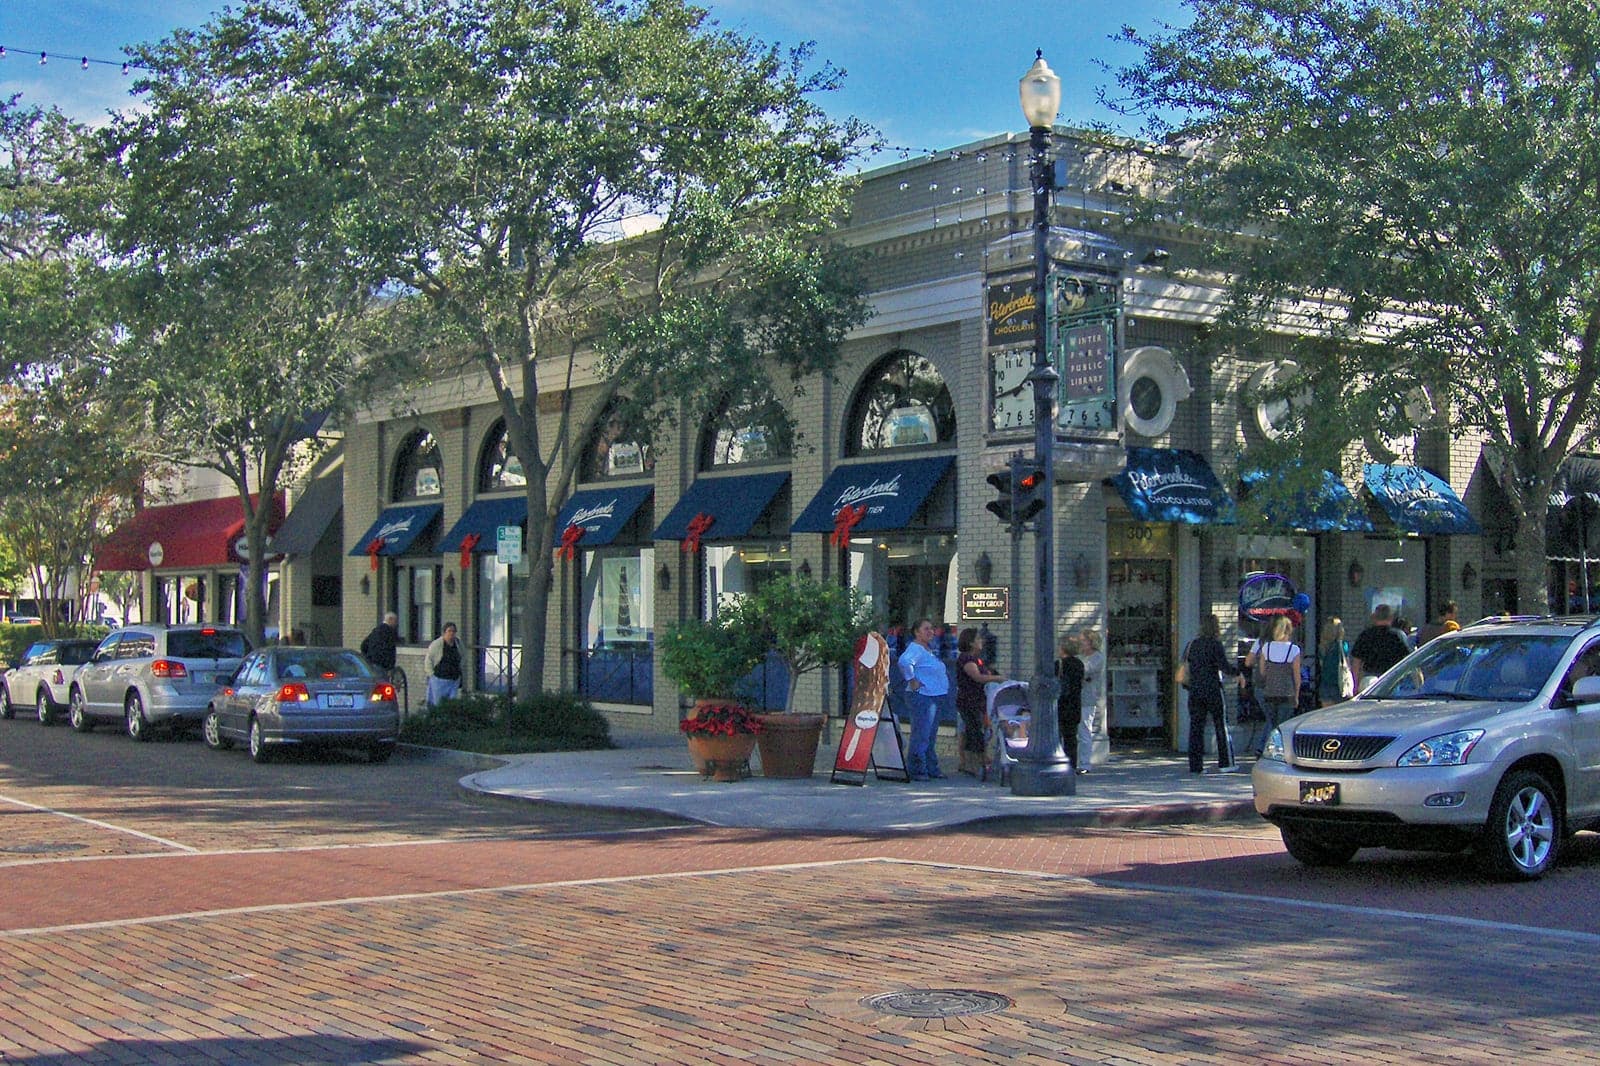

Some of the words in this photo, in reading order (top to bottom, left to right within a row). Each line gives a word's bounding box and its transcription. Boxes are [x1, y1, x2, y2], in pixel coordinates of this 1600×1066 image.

[1070, 335, 1102, 346] WINTER
[1070, 361, 1103, 373] PUBLIC
[998, 370, 1005, 381] 10
[1070, 375, 1103, 386] LIBRARY
[1006, 412, 1011, 423] 7
[1017, 410, 1023, 421] 6
[1029, 409, 1034, 420] 5
[1070, 409, 1075, 420] 7
[1081, 410, 1088, 421] 6
[1095, 411, 1100, 423] 5
[1128, 464, 1194, 493] Peterbrooke
[834, 473, 902, 506] Peterbrooke
[1147, 495, 1213, 506] CHOCOLATIER
[1127, 527, 1152, 539] 300
